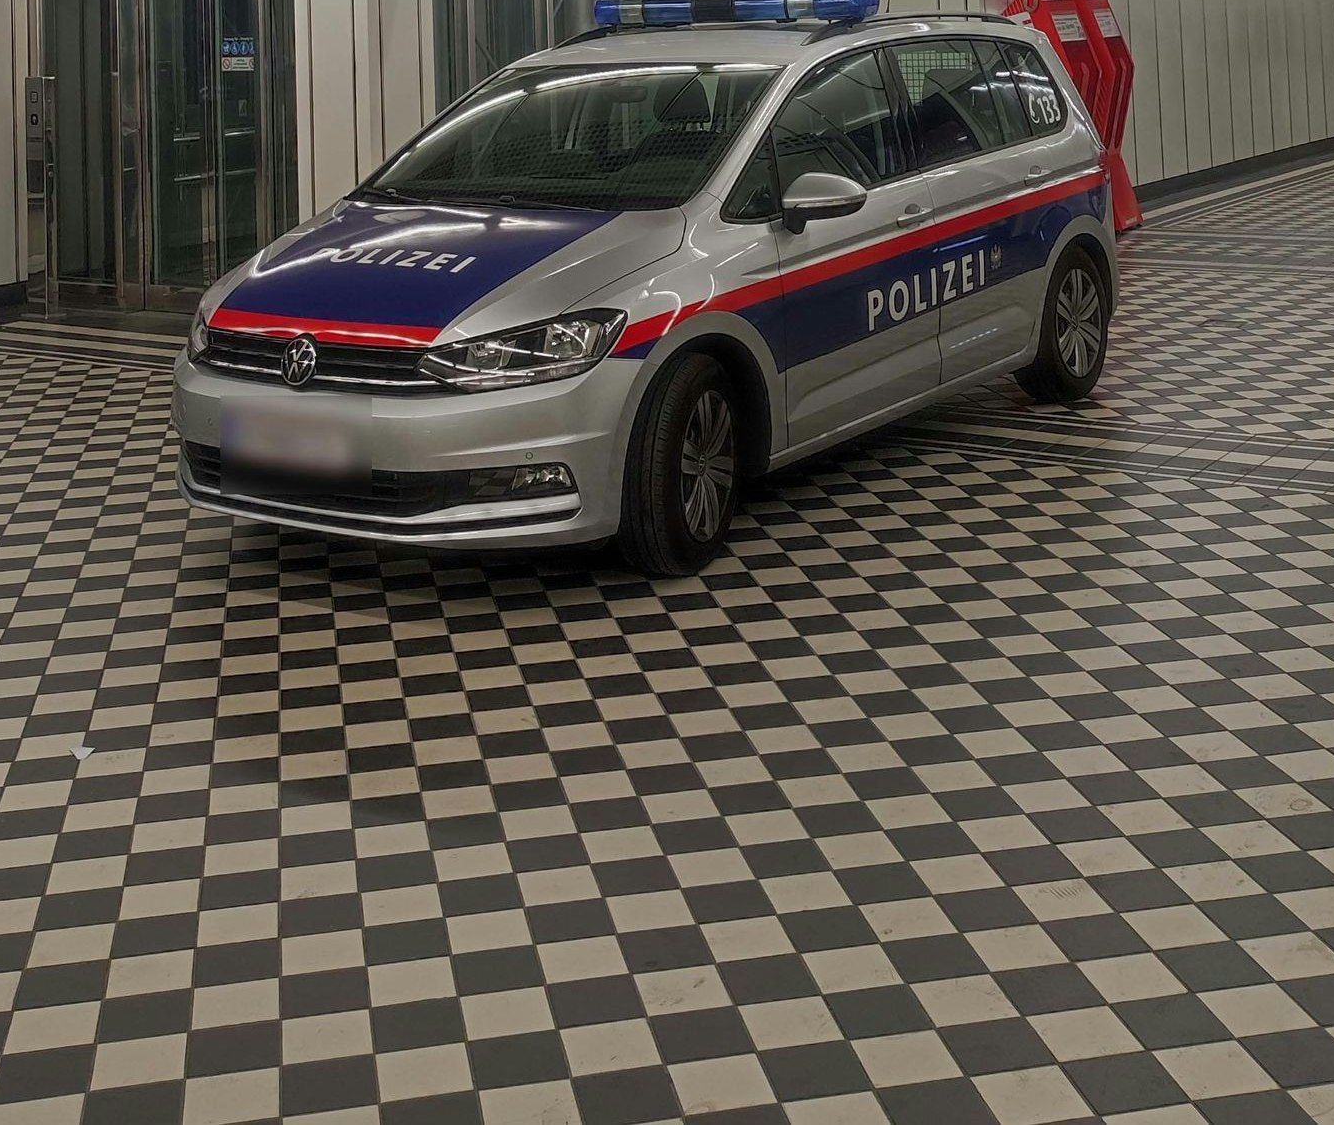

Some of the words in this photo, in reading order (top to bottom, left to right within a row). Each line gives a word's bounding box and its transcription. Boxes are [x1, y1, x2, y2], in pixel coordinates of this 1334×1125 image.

[1037, 93, 1061, 125] 133
[317, 247, 477, 274] POLIZEI
[868, 249, 985, 332] POLIZEI
